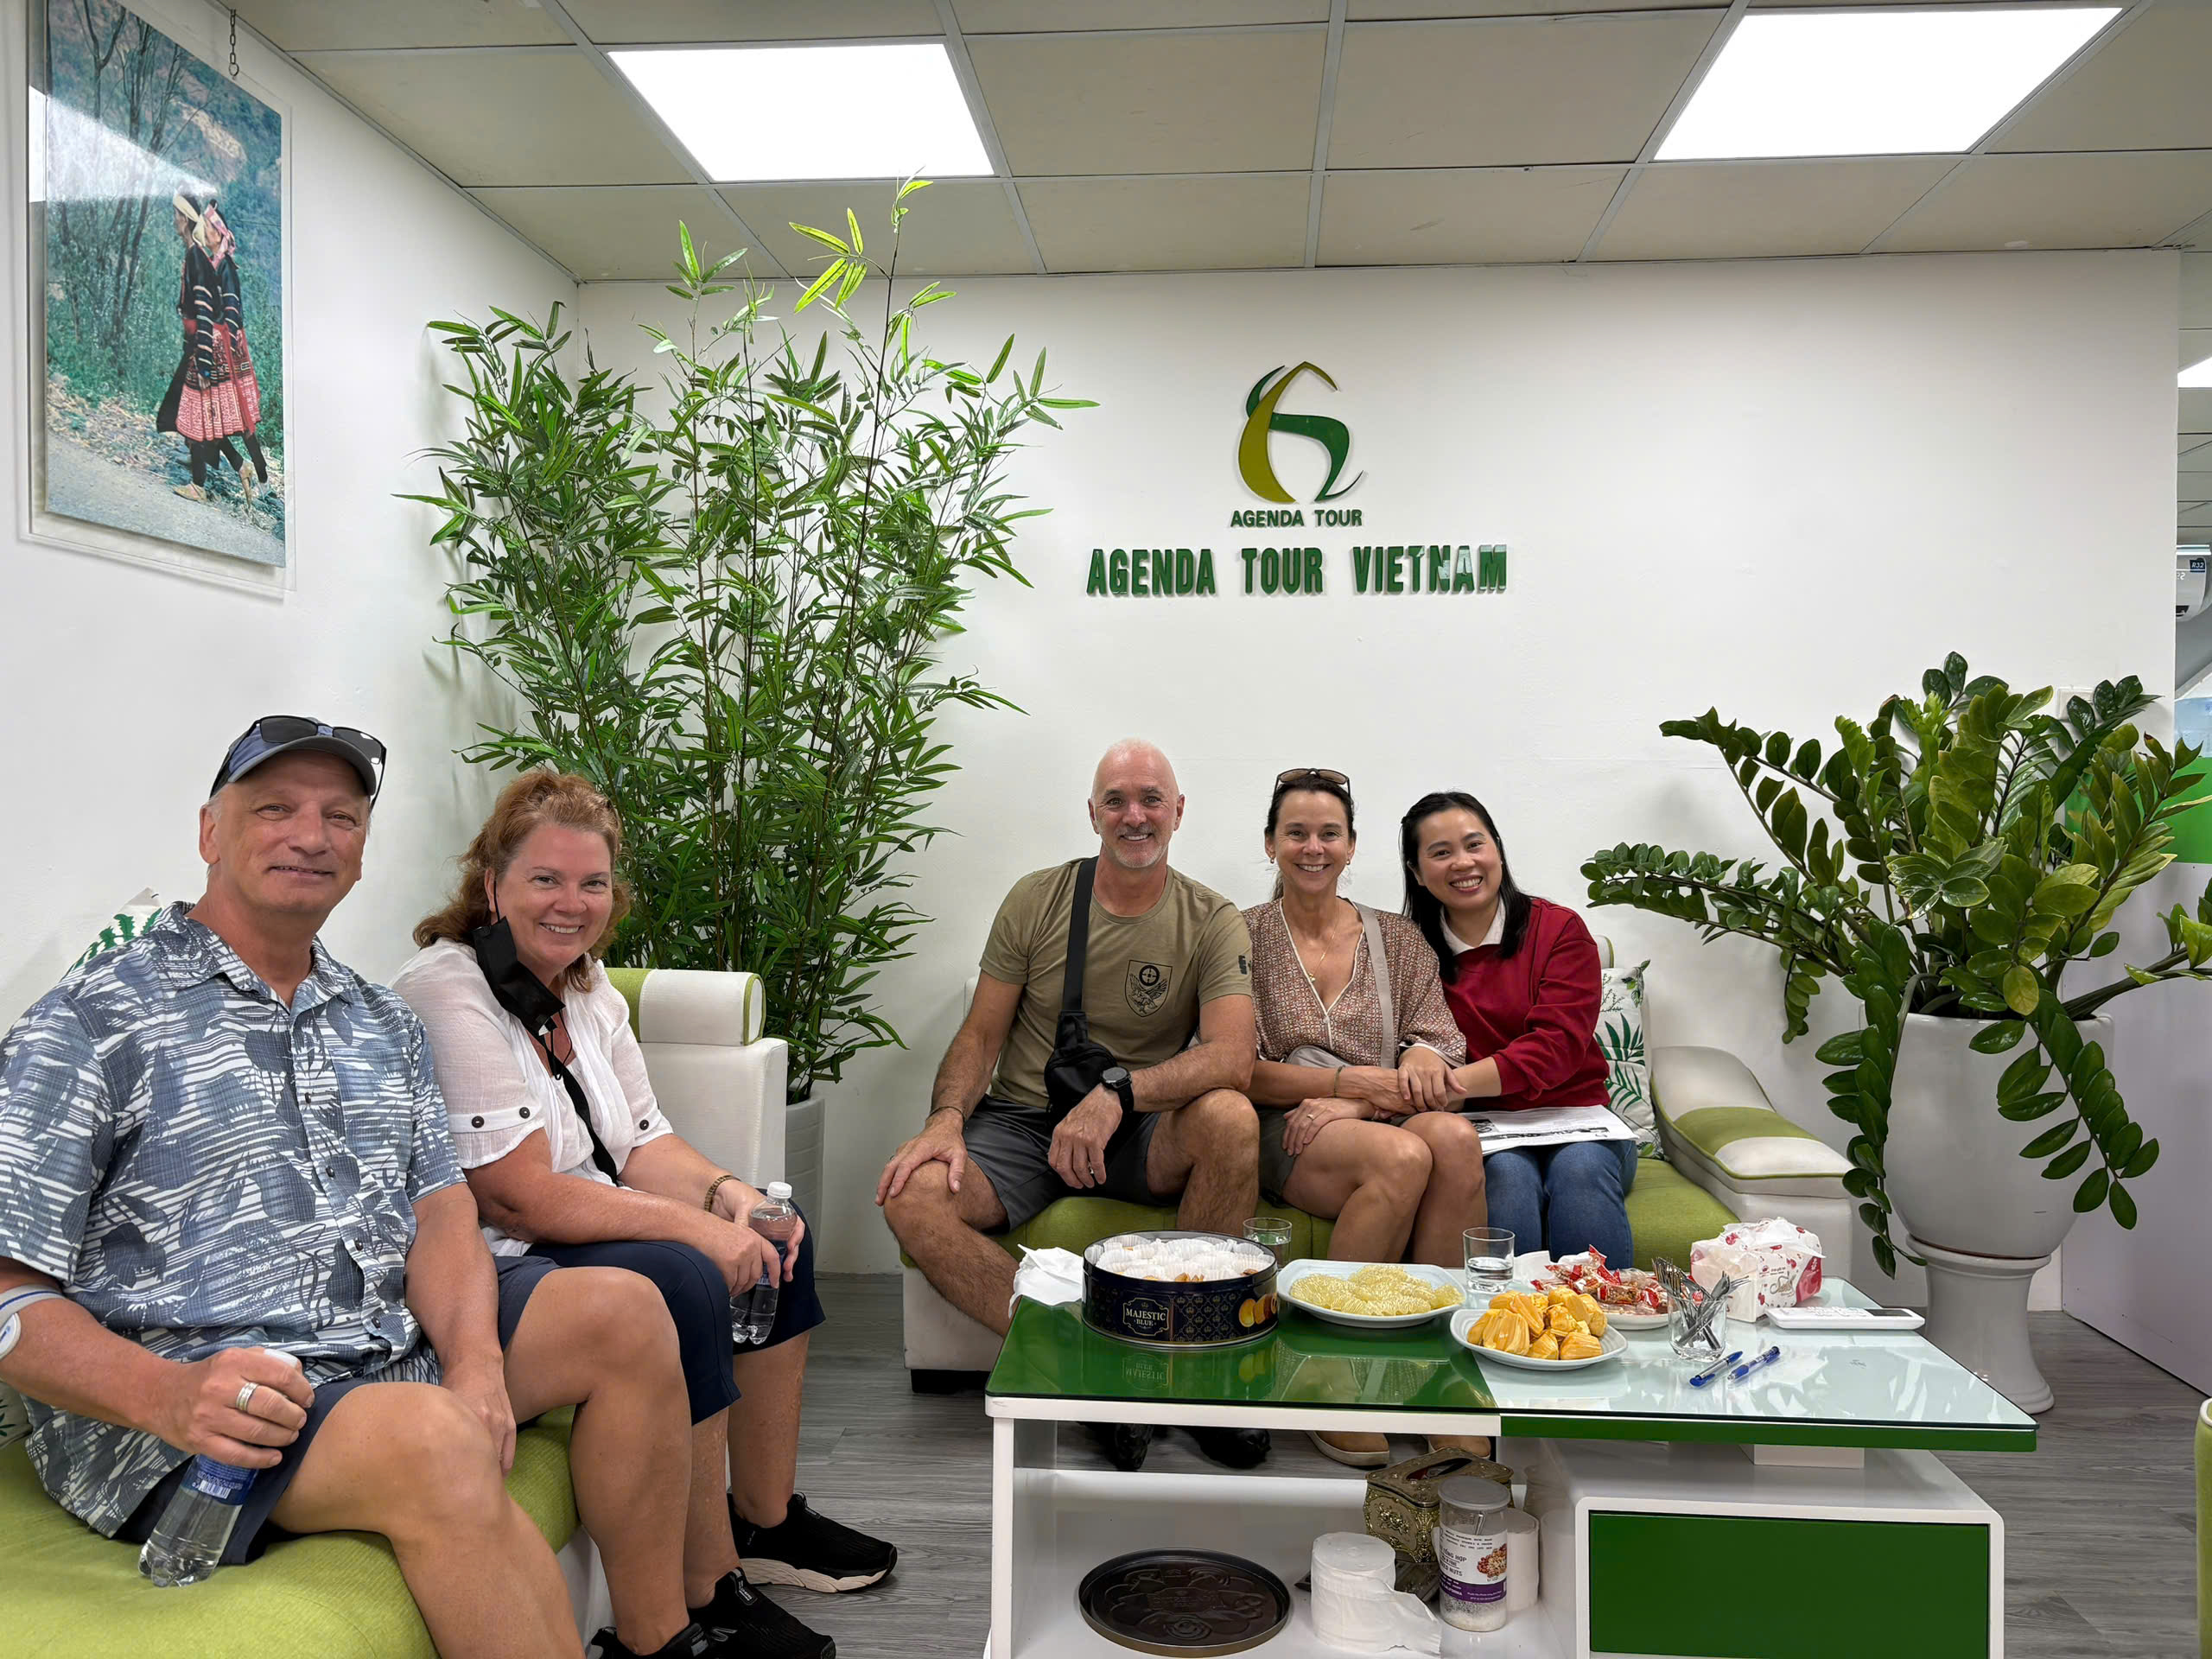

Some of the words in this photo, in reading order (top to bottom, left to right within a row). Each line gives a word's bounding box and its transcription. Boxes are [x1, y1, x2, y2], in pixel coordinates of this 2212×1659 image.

[1230, 510, 1305, 527] AGENDA
[1314, 509, 1363, 526] TOUR
[1086, 549, 1216, 594] AGENDA
[1241, 548, 1323, 594] TOUR
[1352, 544, 1507, 594] VIETNAM
[1126, 1308, 1166, 1321] MAJESTIC
[1449, 1567, 1463, 1577] NUTS
